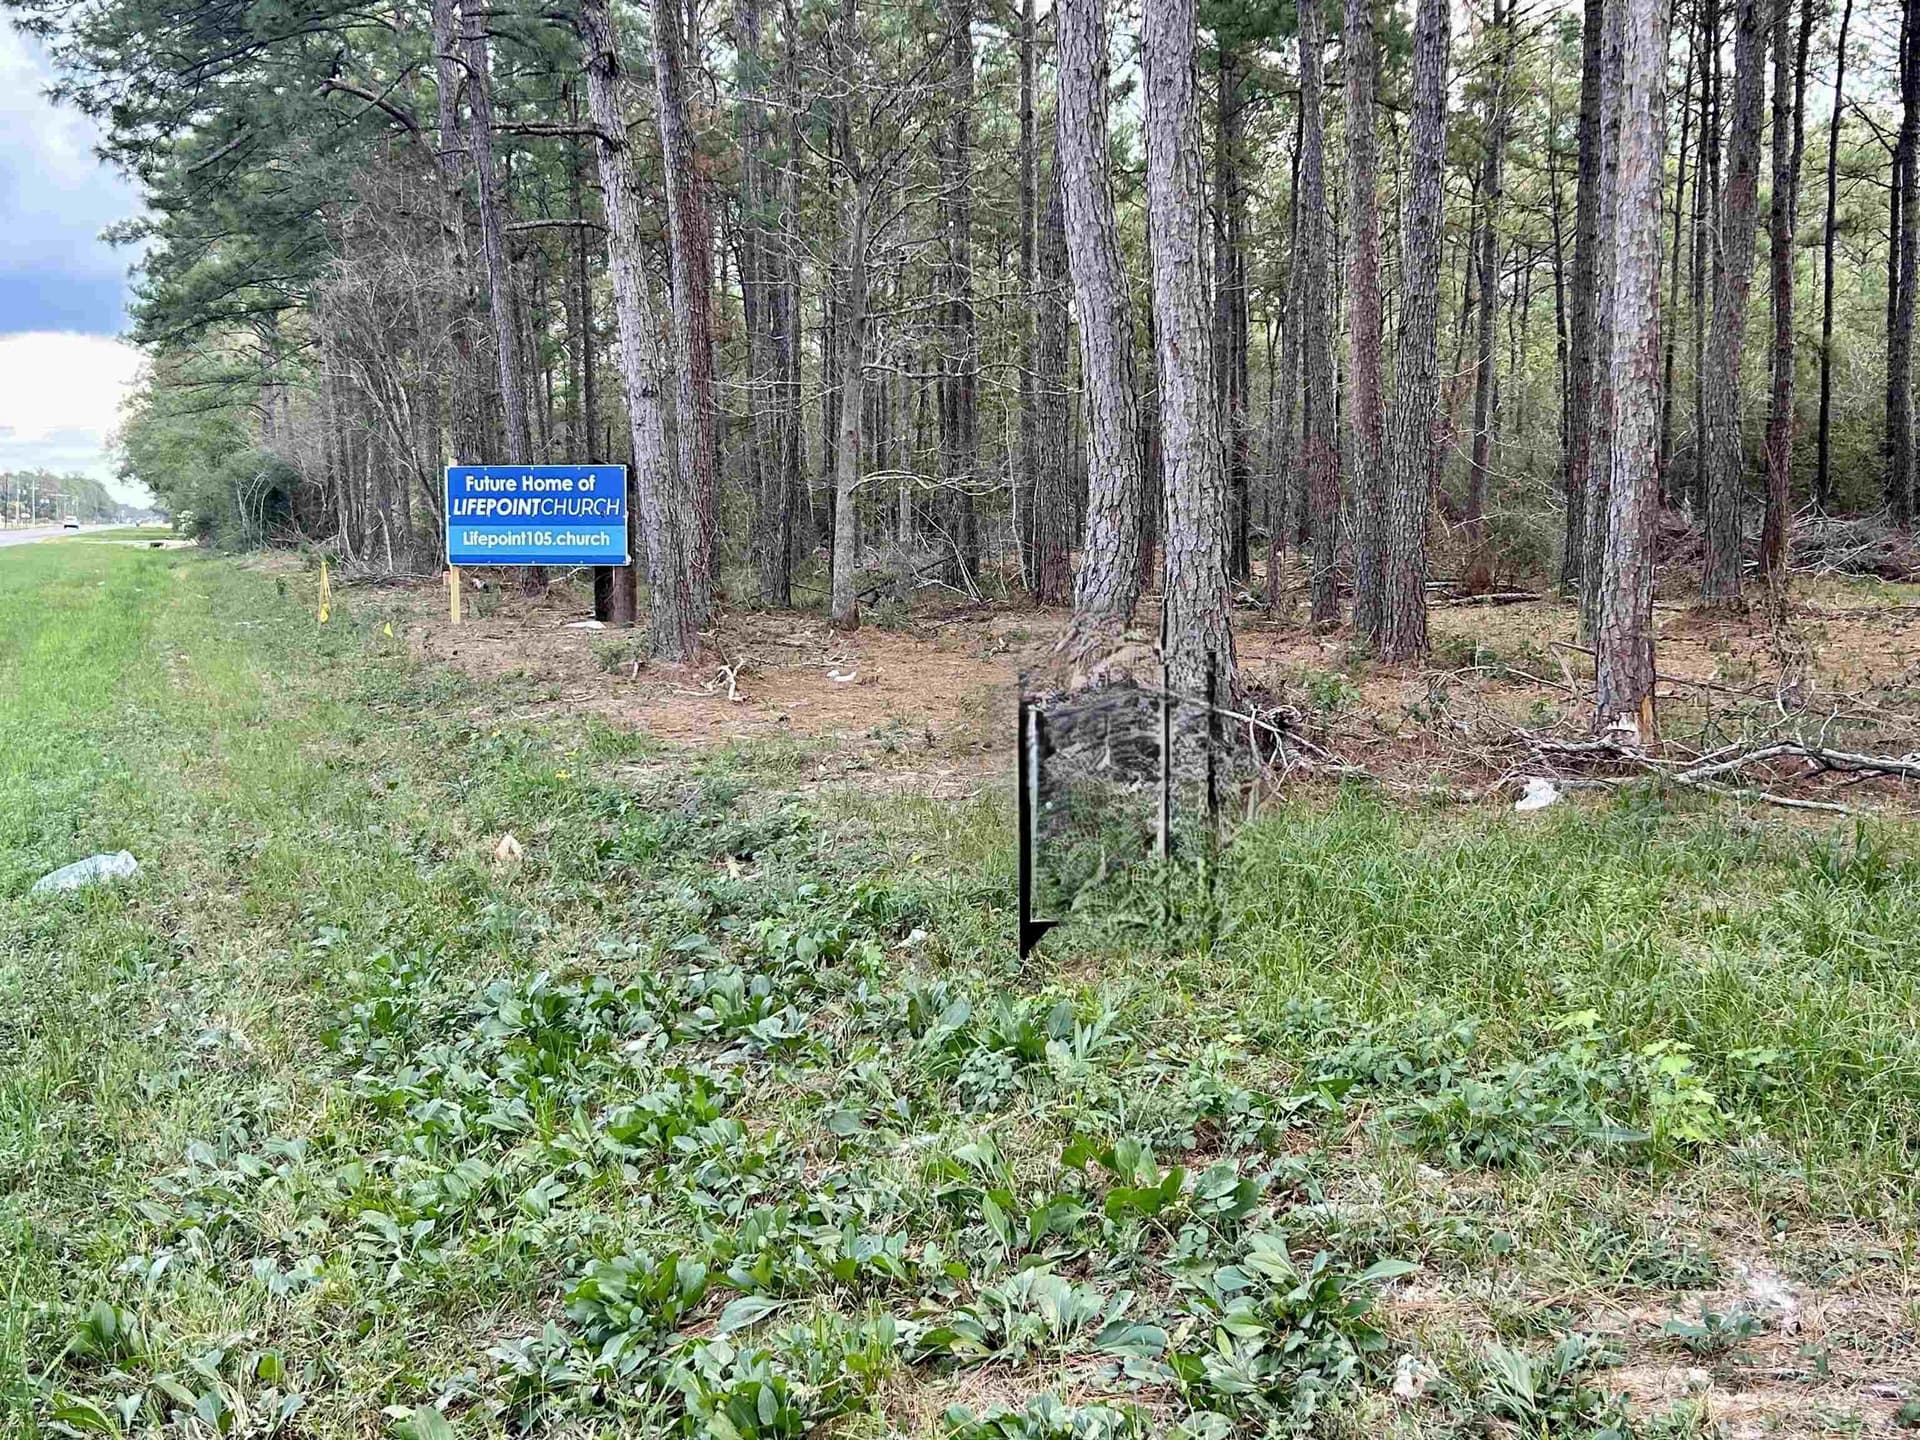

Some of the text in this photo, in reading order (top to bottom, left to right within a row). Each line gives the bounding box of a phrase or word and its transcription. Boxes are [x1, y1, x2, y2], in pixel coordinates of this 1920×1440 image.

[466, 474, 597, 492] Future Home of
[463, 530, 610, 548] Lifepoint105.church
